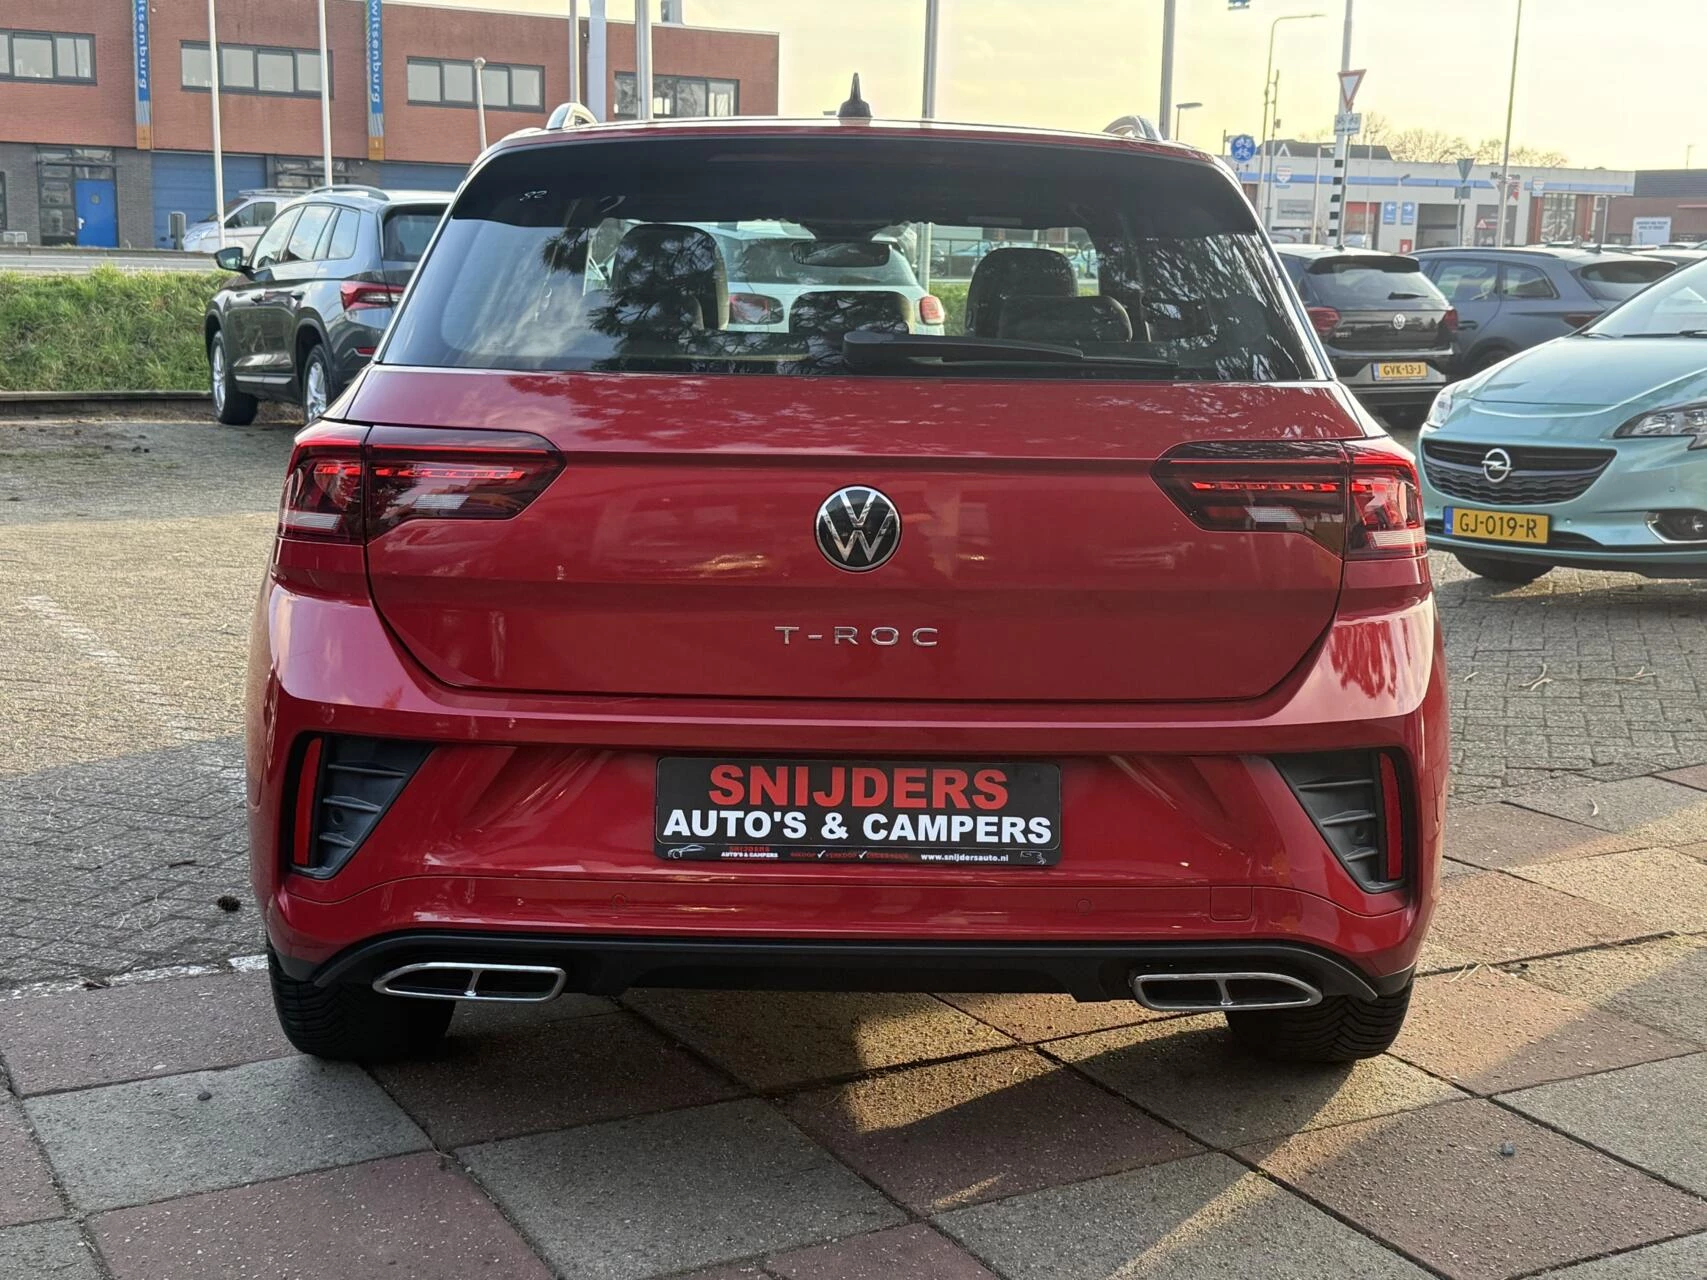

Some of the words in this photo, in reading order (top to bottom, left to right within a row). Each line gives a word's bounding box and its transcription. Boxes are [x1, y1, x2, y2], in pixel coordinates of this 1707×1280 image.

[1383, 364, 1422, 376] GVK-13-J
[1459, 512, 1537, 539] GJ-019-R
[774, 625, 938, 646] T-ROC
[708, 764, 1009, 810] SNIJDERS
[663, 809, 807, 839] AUTO'S
[820, 812, 849, 840] &
[862, 812, 1052, 844] CAMPERS
[920, 852, 1009, 863] www.snijdersauto.nl
